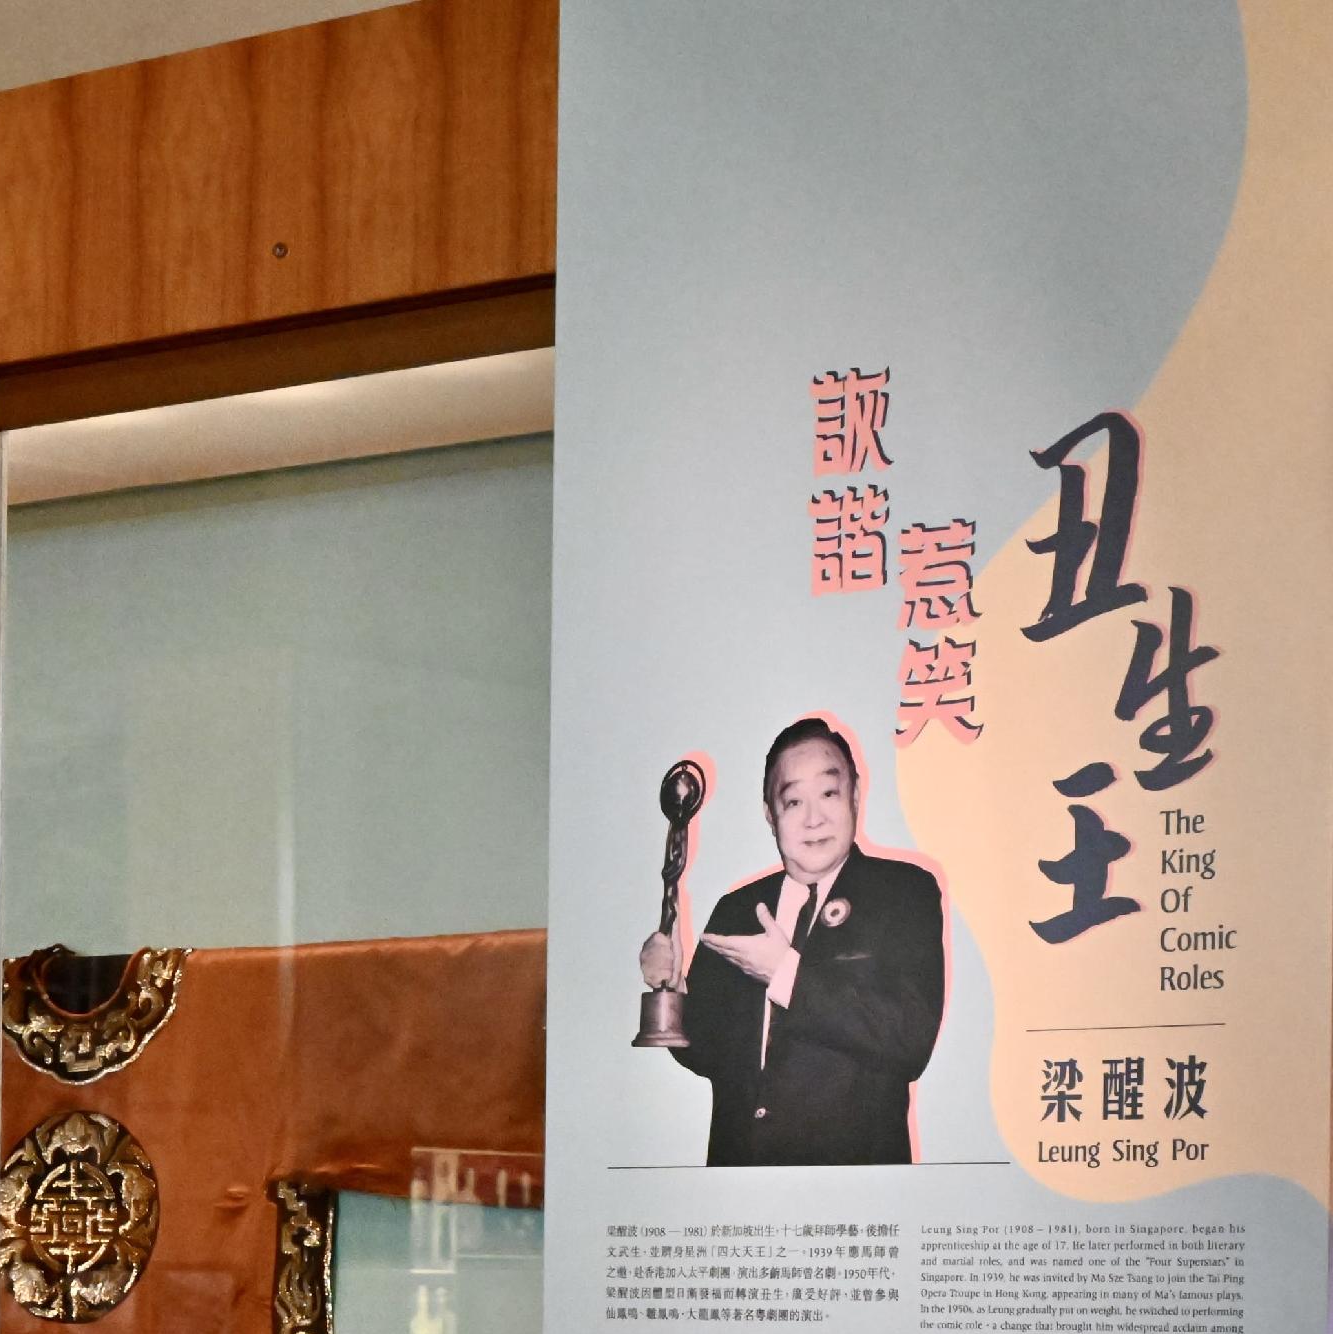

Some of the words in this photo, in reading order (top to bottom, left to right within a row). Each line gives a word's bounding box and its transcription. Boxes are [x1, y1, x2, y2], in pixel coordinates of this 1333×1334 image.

[808, 365, 893, 597] 詼諧
[895, 517, 983, 747] 惹笑
[1021, 408, 1223, 944] 丑生王
[1160, 810, 1206, 836] The
[1160, 847, 1217, 878] King
[1160, 886, 1193, 914] Of
[1159, 924, 1237, 953] Comic
[1159, 963, 1225, 992] Roles
[1040, 1056, 1209, 1122] 梁醒波
[1037, 1138, 1101, 1166] Leung
[1112, 1138, 1159, 1166] Sing
[1171, 1138, 1209, 1161] Por
[921, 1222, 952, 1237] Leung
[955, 1222, 978, 1237] Sing
[982, 1222, 999, 1234] Por
[1085, 1221, 1110, 1234] born
[1114, 1221, 1125, 1234] in
[1192, 1221, 1224, 1236] began
[1229, 1221, 1245, 1234] his
[920, 1254, 937, 1267] and
[942, 1254, 973, 1267] martial
[1007, 1254, 1025, 1267] and
[1030, 1257, 1047, 1267] was
[1052, 1254, 1083, 1267] named
[1088, 1257, 1106, 1267] one
[1110, 1254, 1120, 1267] of
[1125, 1254, 1140, 1267] the
[1234, 1254, 1244, 1267] in
[969, 1270, 978, 1283] In
[1009, 1270, 1020, 1283] he
[1023, 1273, 1040, 1283] was
[1043, 1270, 1074, 1283] invited
[1076, 1270, 1087, 1285] by
[1090, 1270, 1105, 1283] Ma
[1108, 1270, 1124, 1283] Sze
[1126, 1271, 1153, 1286] Tsang
[1155, 1271, 1164, 1283] to
[1167, 1271, 1186, 1286] join
[1189, 1271, 1204, 1283] the
[1207, 1271, 1220, 1283] Tai
[1223, 1271, 1244, 1286] Ping
